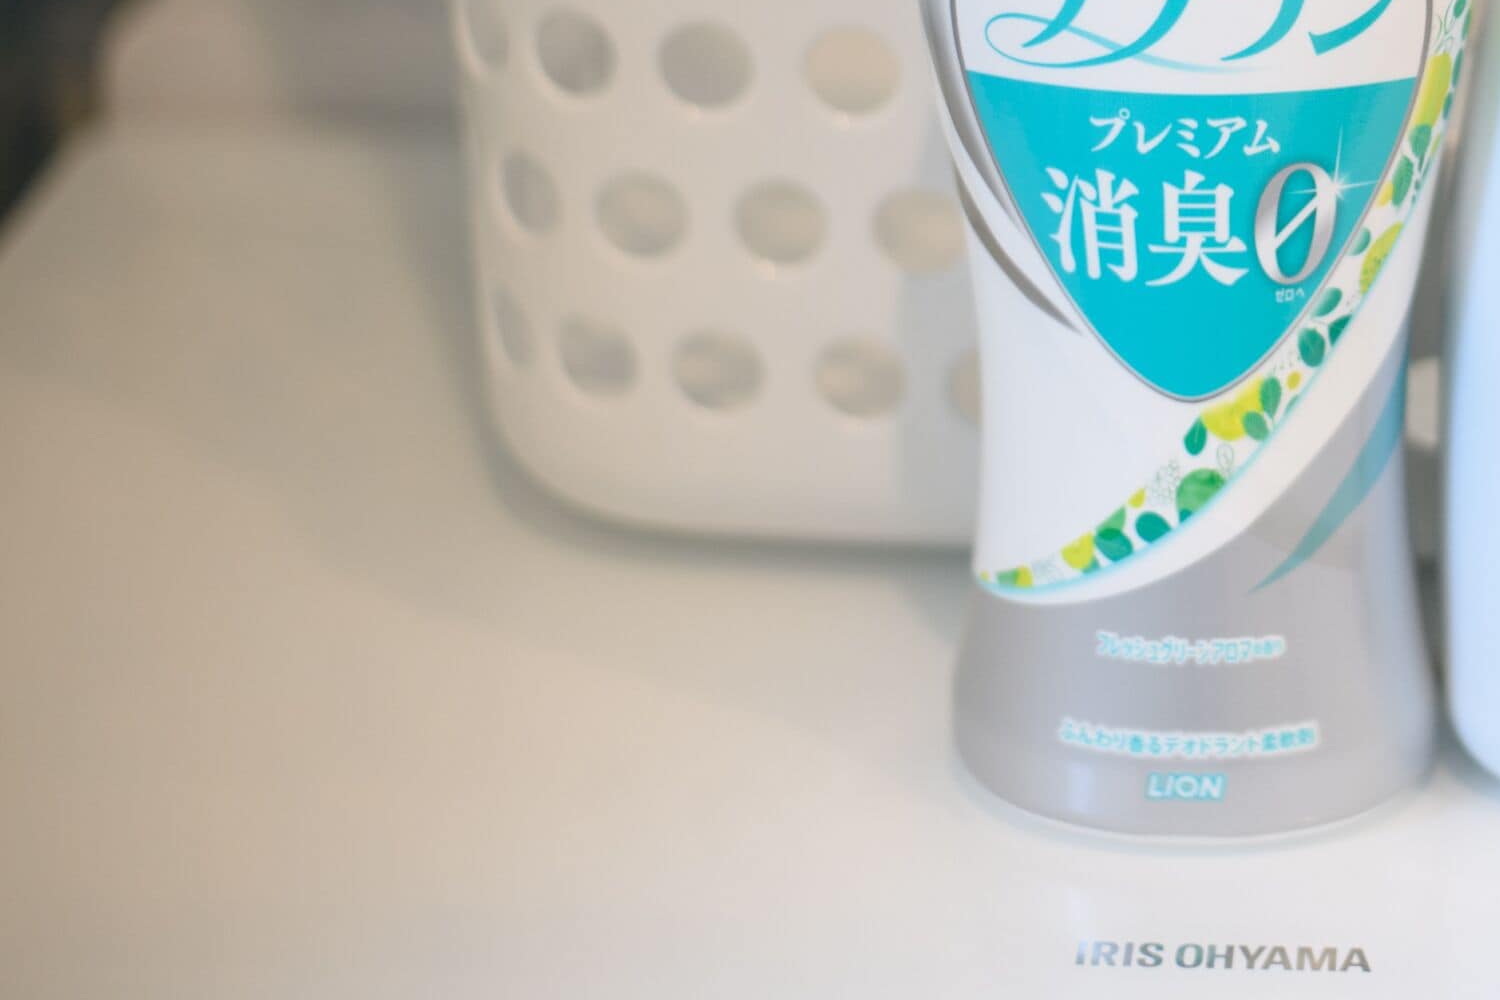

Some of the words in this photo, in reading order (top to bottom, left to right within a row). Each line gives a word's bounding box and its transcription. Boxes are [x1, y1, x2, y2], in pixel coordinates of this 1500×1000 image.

[1089, 109, 1280, 158] プレミアム
[1147, 773, 1226, 799] LION
[1074, 940, 1164, 968] IRIS
[1174, 942, 1372, 973] OHYAMA
